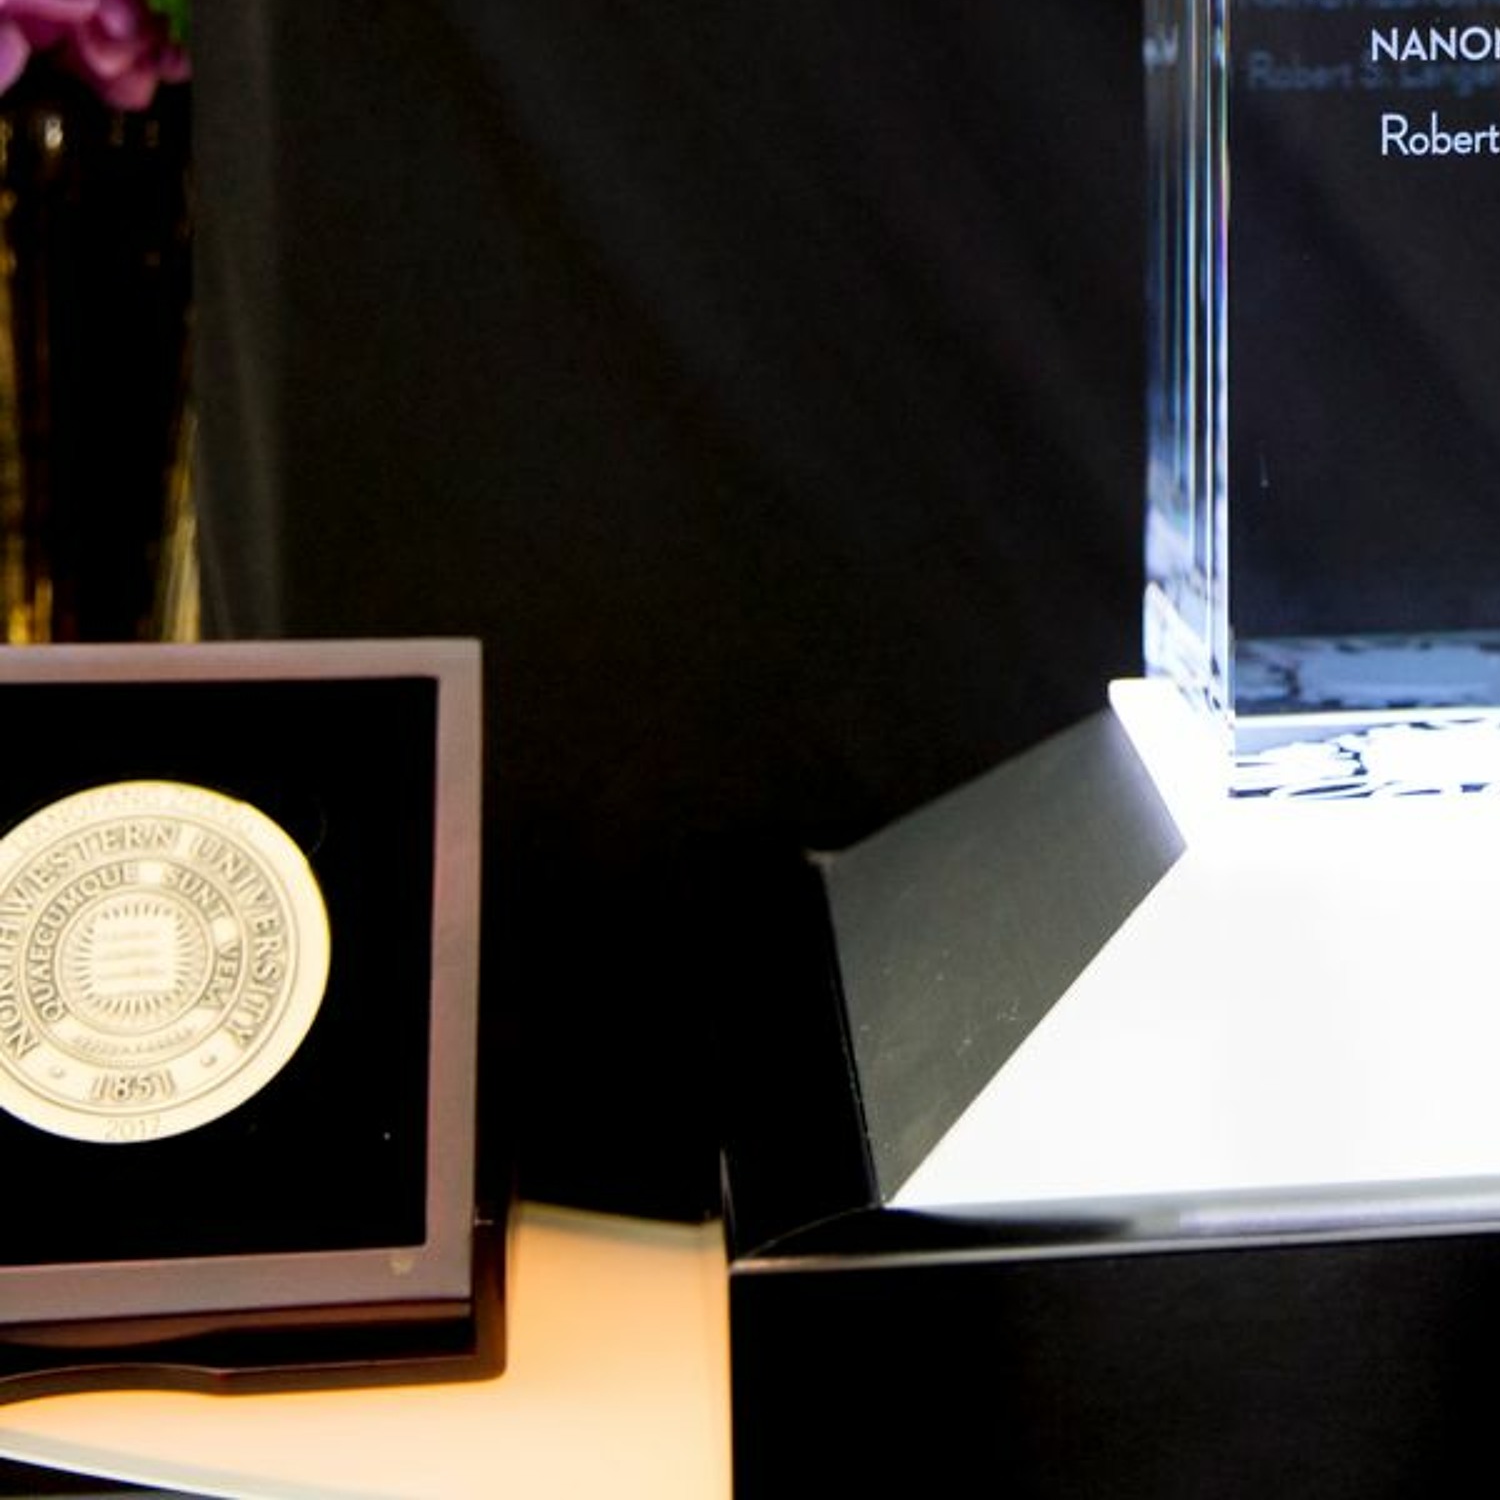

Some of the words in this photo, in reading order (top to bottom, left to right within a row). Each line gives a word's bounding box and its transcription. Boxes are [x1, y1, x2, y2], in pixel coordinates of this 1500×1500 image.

[1381, 111, 1500, 156] Robert
[160, 864, 227, 921] SUNT
[190, 834, 283, 1049] UNIVERSITY
[91, 1067, 177, 1102] 1851
[103, 1114, 161, 1141] 2017
